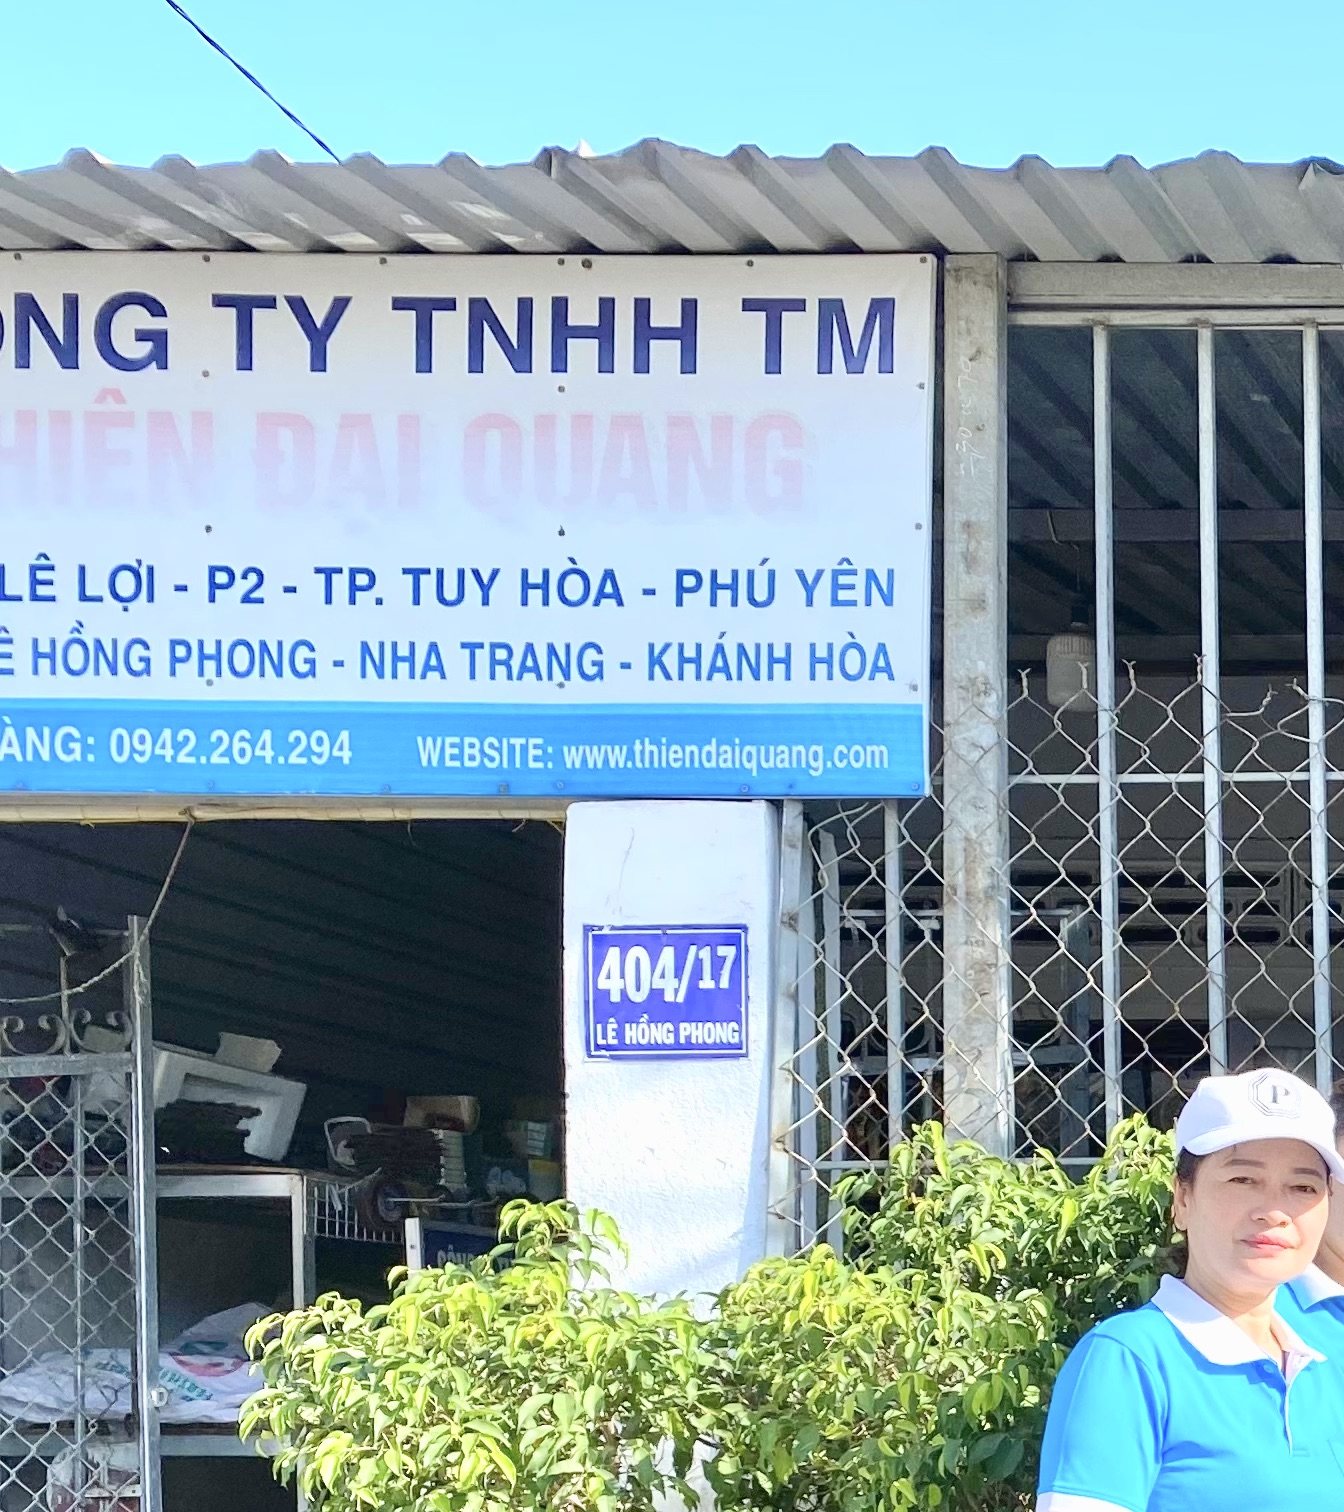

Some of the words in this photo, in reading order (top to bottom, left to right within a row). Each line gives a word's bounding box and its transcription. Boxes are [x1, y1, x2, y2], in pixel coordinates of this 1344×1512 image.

[0, 290, 169, 373] NG
[211, 292, 353, 373] TY
[391, 296, 698, 374] TNHH
[741, 297, 896, 375] TM
[461, 410, 812, 527] QUANG
[77, 558, 155, 612] LỢI
[207, 564, 265, 604] P2
[313, 566, 384, 606] TP.
[401, 567, 501, 608] TUY
[520, 557, 625, 608] HÒA
[675, 557, 776, 608] PHÚ
[794, 557, 895, 608] YÊN
[31, 620, 152, 678] HỒNG
[168, 638, 317, 680] PHONG
[360, 640, 447, 680] NHA
[460, 641, 605, 683] TRANG
[647, 631, 792, 682] KHÁNH
[808, 631, 895, 682] HÒA
[108, 727, 352, 766] 0942.264.294
[416, 735, 553, 770] WEBSITE:
[563, 736, 889, 777] www.thiendaiquang.com
[596, 944, 738, 1004] 404/17
[596, 1016, 619, 1045] LÊ
[624, 1012, 675, 1045] HỒNG
[679, 1020, 740, 1045] PHONG
